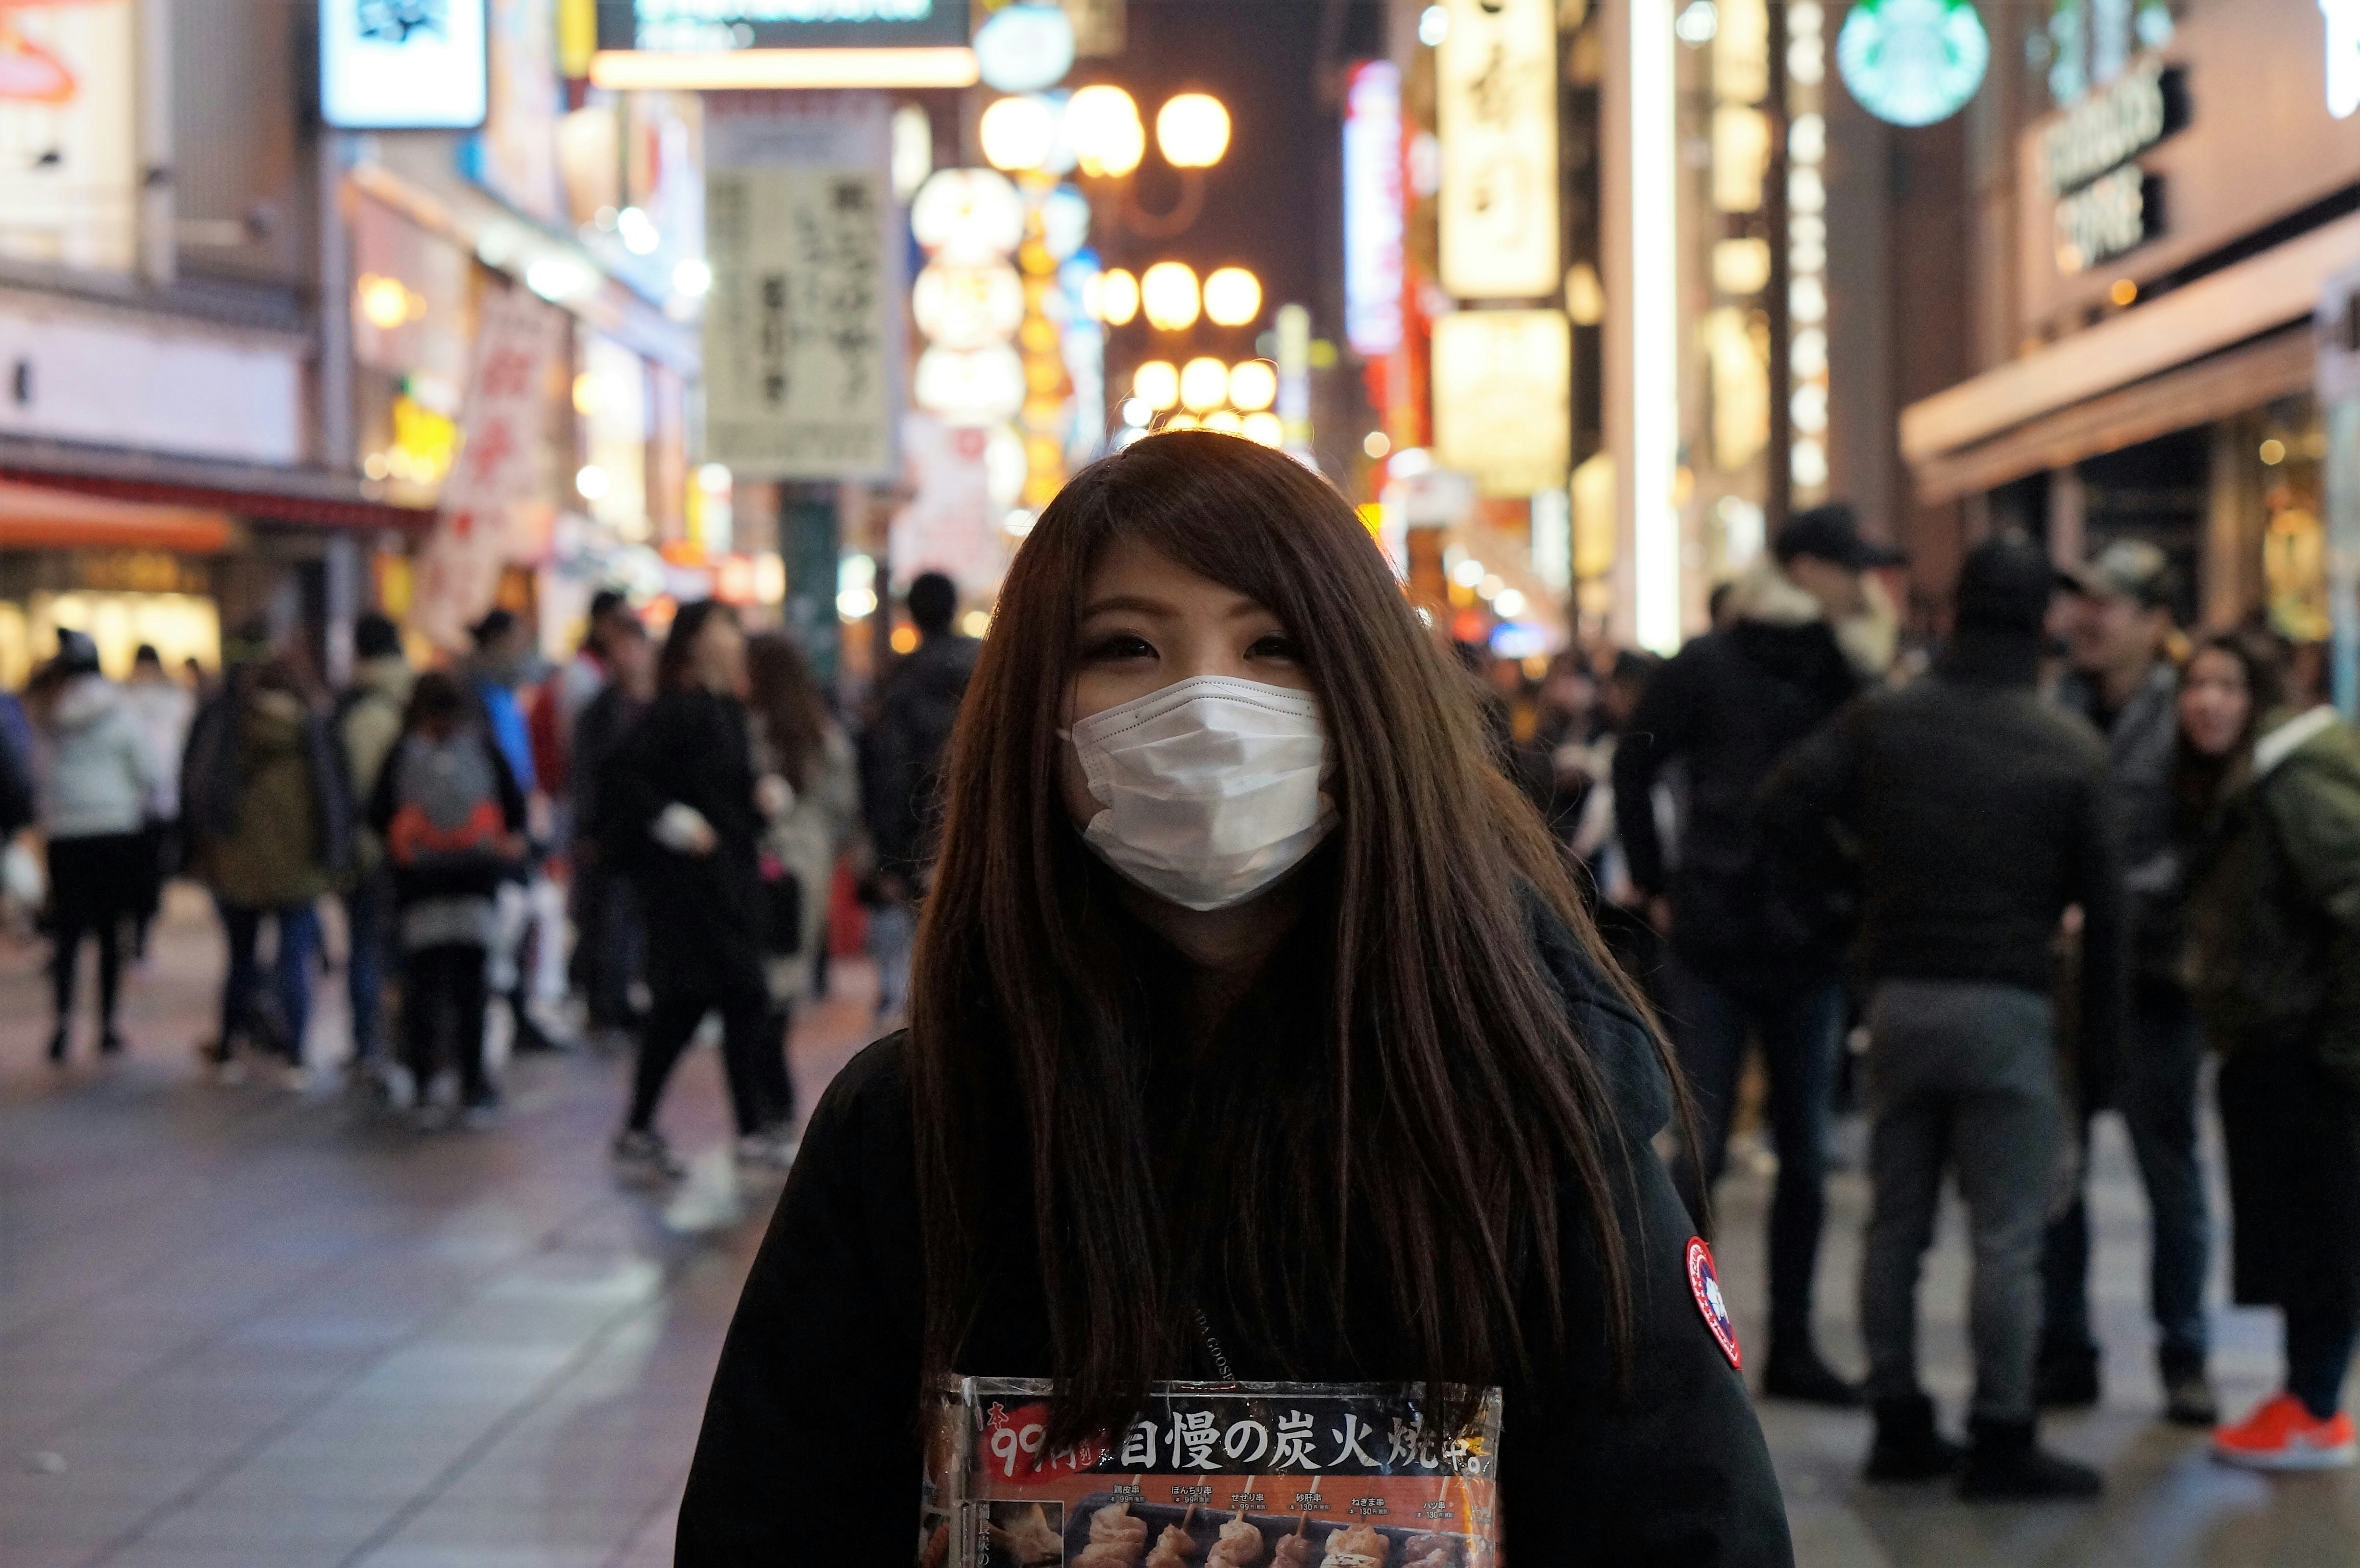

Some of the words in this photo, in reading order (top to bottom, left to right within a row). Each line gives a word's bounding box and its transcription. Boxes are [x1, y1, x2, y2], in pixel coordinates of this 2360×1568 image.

[1231, 1494, 1264, 1502] せせり串
[1352, 1498, 1384, 1507] ねぎま串
